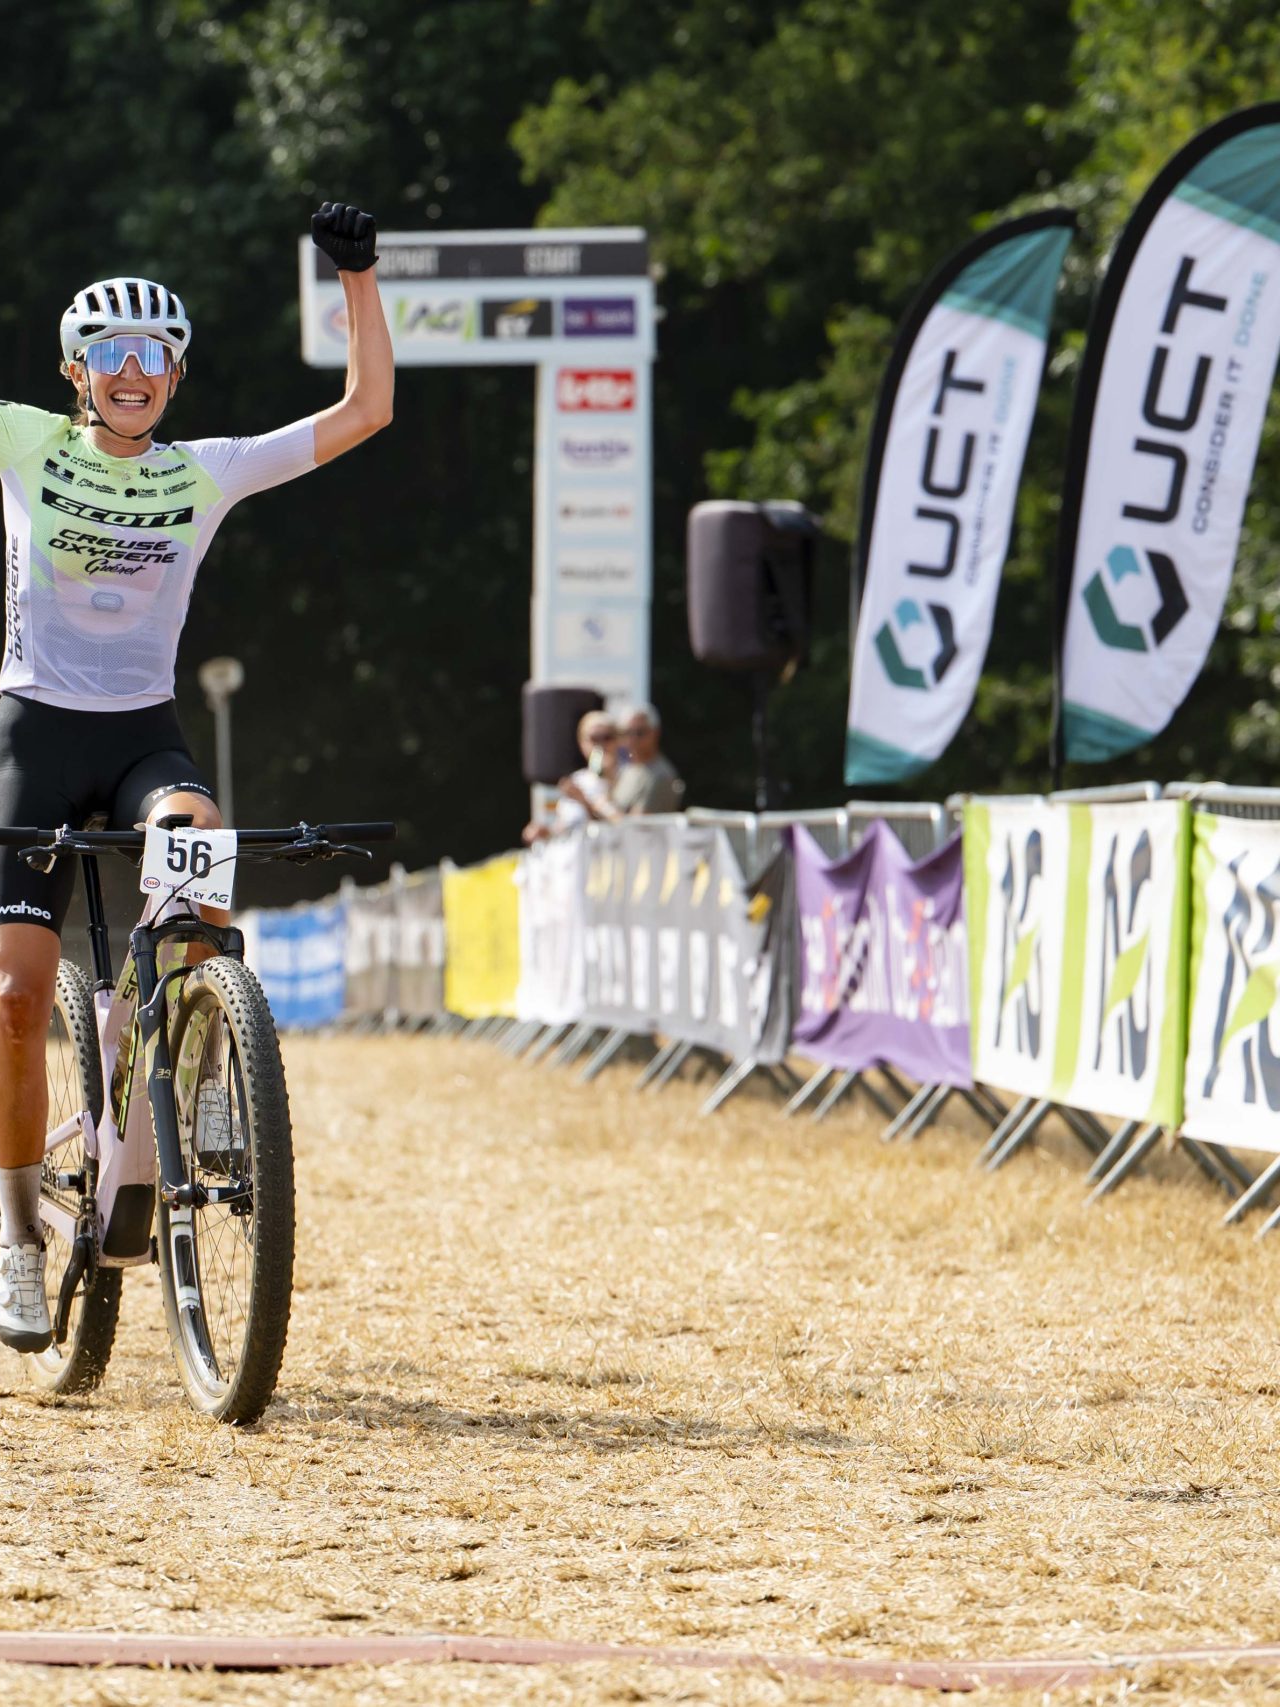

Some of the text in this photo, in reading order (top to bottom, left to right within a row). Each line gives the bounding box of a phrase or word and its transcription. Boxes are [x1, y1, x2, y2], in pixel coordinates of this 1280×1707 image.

[1122, 255, 1228, 524] UCT
[1192, 271, 1269, 535] CONSIDER IT DONE
[907, 350, 985, 578] UCT
[50, 497, 186, 528] SCOTT
[48, 538, 179, 563] OXYGENE
[58, 528, 172, 551] CREUSE
[11, 533, 23, 662] OXYGENE
[166, 836, 212, 879] 56
[193, 891, 205, 900] EY
[208, 892, 229, 904] AG
